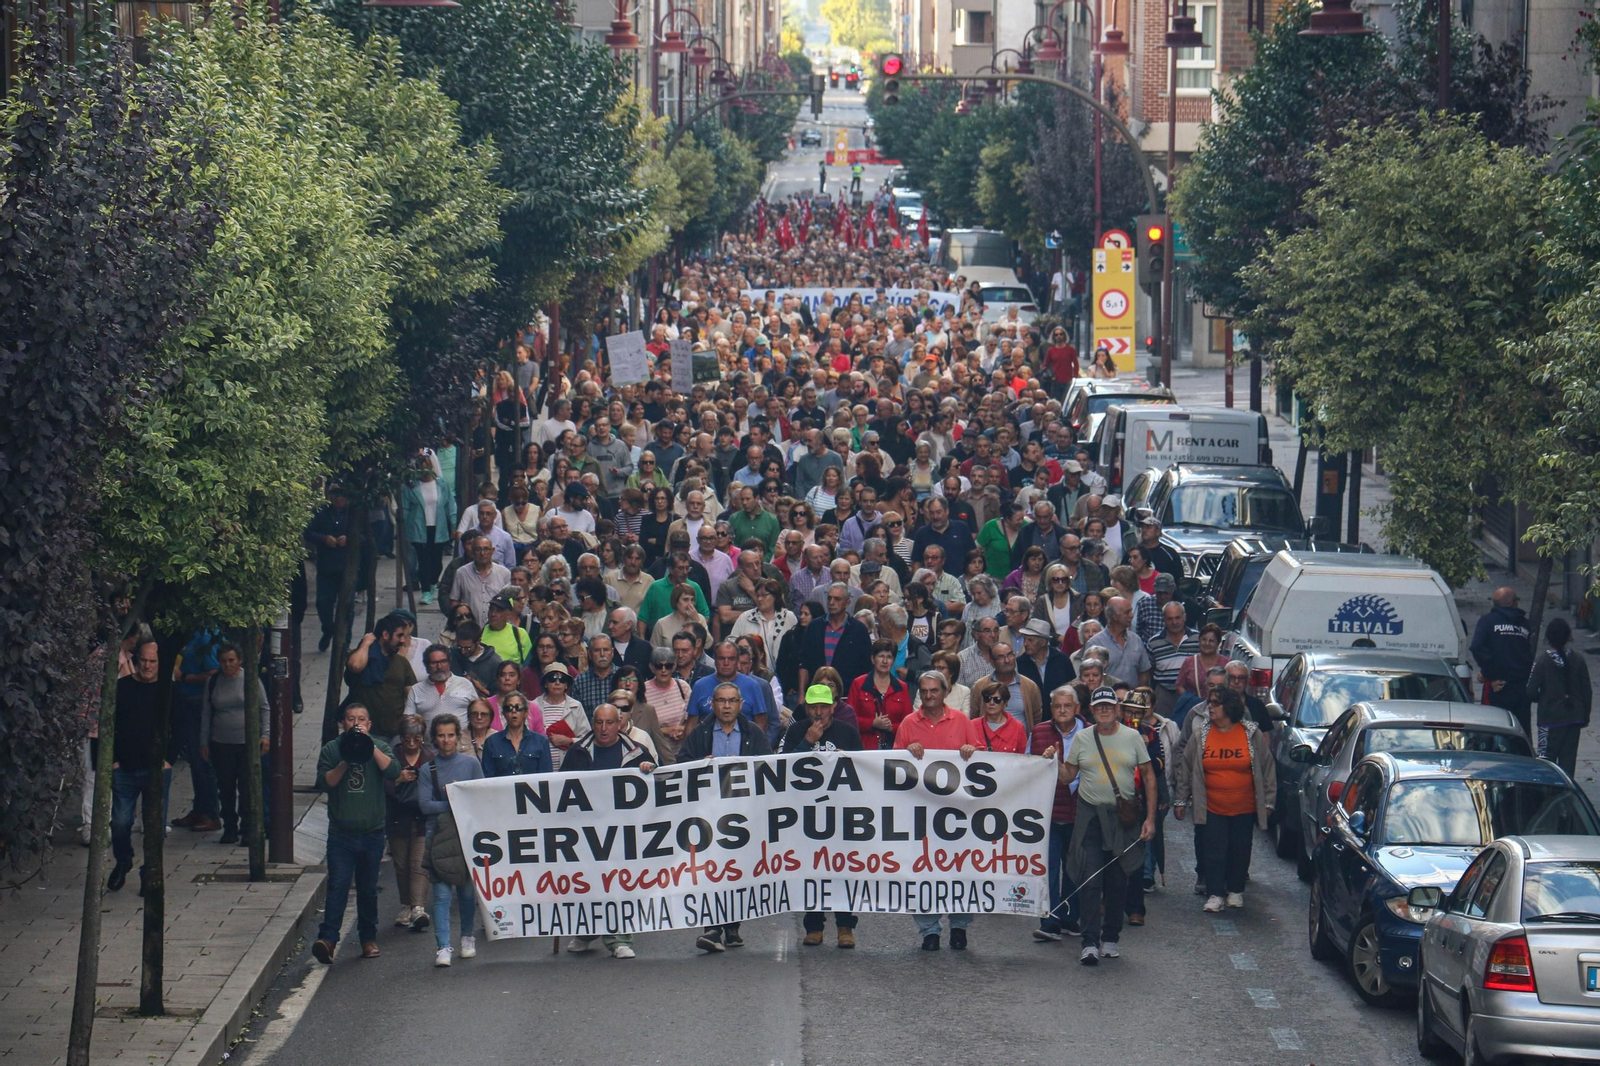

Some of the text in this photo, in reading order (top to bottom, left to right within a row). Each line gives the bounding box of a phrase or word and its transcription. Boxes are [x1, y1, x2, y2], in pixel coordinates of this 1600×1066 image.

[1146, 429, 1240, 452] LM RENT A CAR
[1332, 620, 1394, 634] TREVAL
[1341, 600, 1386, 616] TALLERES
[514, 756, 998, 814] NA DEFENSA DOS
[472, 794, 1046, 867] SERVIZOS PÚBLICOS
[472, 834, 1047, 901] Non aos recortes dos nosos dereitos
[521, 879, 995, 936] PLATAFORMA SANITARIA DE VALDEORRAS
